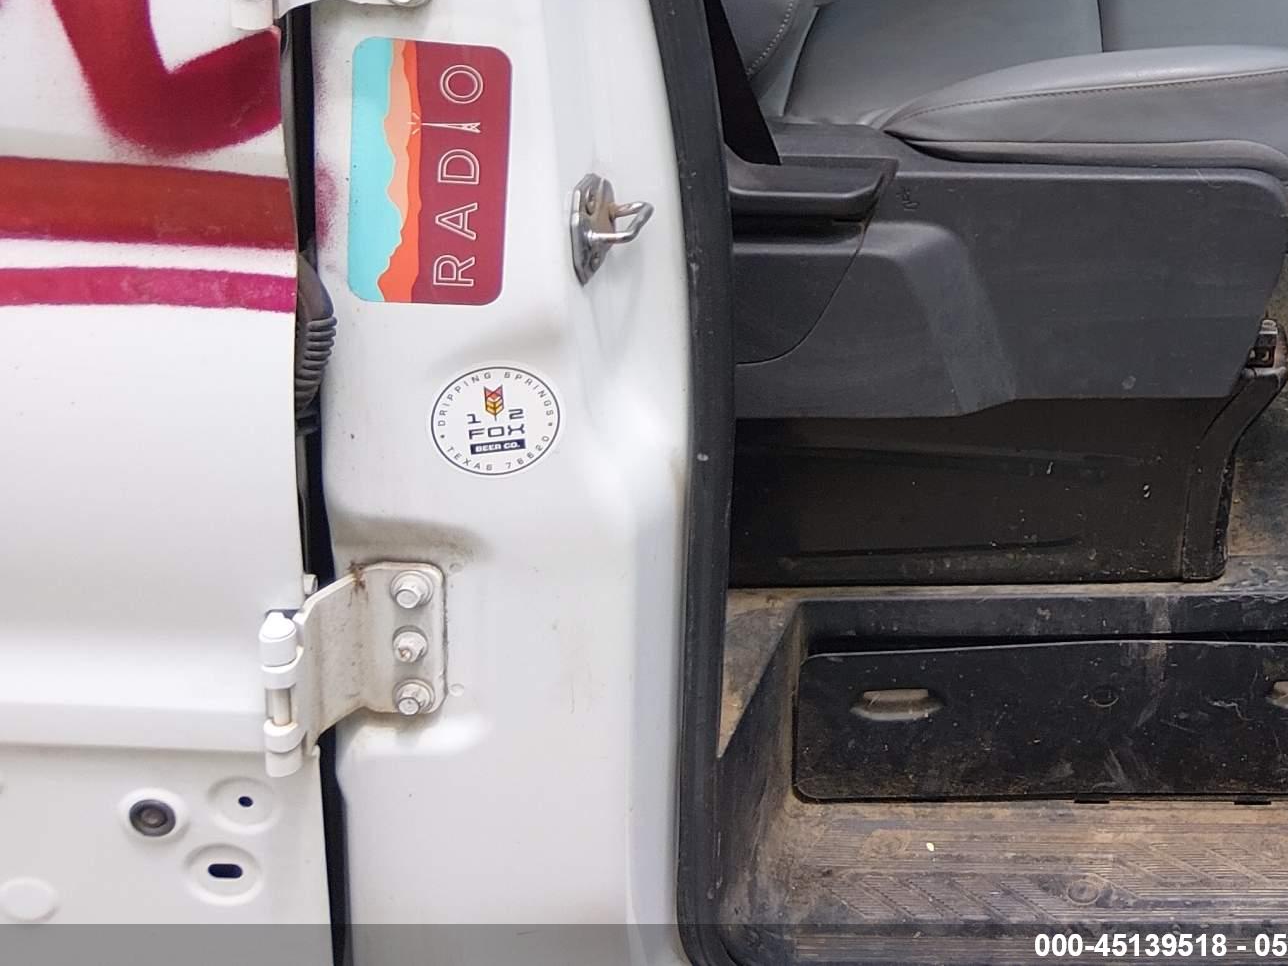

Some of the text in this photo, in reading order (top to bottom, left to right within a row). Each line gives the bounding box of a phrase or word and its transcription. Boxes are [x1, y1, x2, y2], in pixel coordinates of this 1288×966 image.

[428, 64, 484, 287] RADIO
[438, 371, 554, 426] DRIPPING SPRINGS
[469, 424, 525, 440] FOX
[447, 446, 492, 470] TEXAS
[475, 443, 502, 453] BEER
